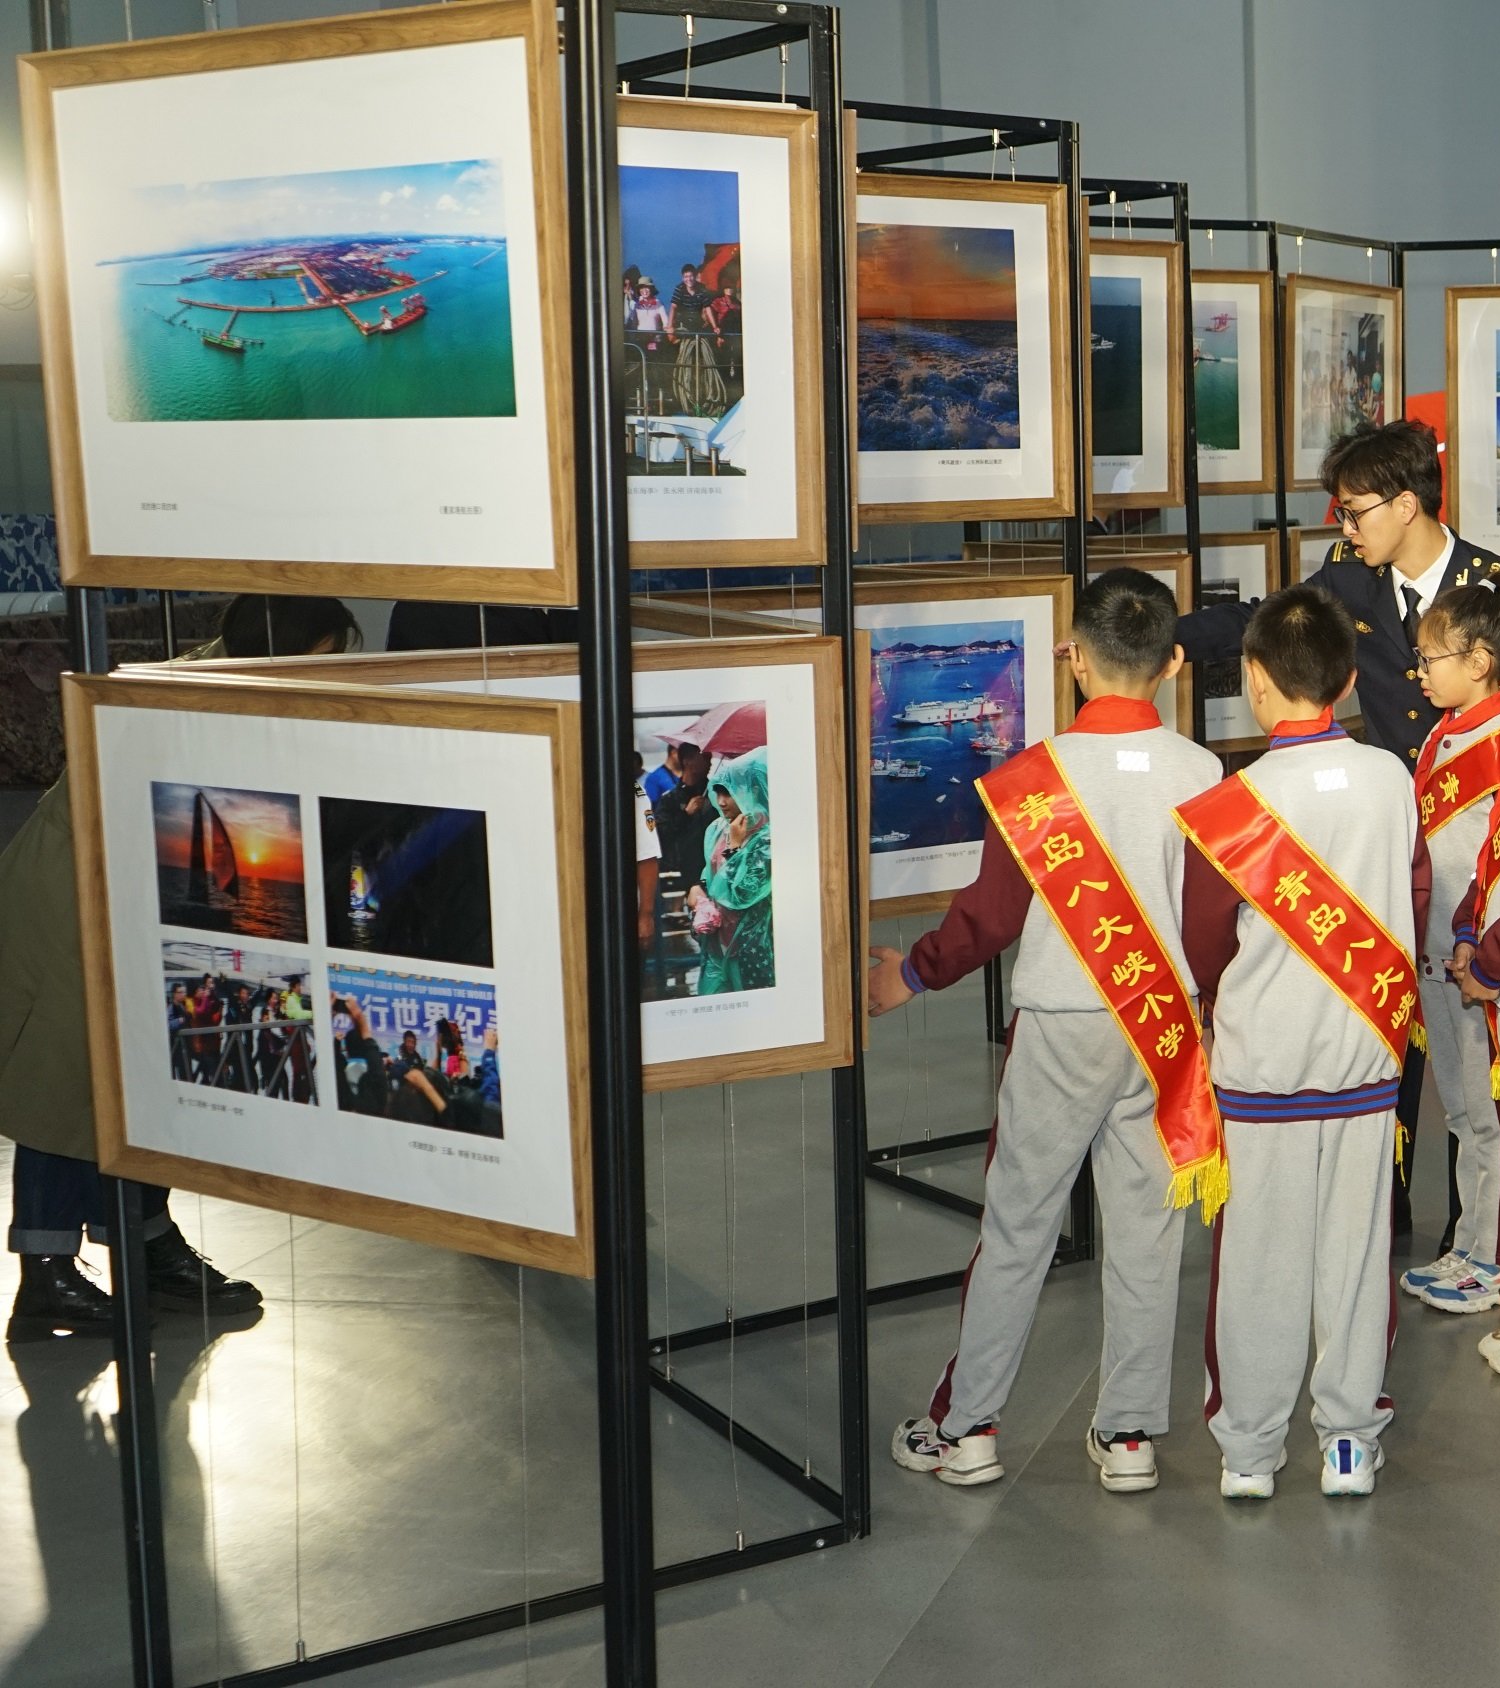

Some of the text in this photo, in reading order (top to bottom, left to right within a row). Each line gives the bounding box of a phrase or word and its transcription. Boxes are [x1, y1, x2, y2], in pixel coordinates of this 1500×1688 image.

[1015, 791, 1185, 1059] 青岛八大峡小学
[1274, 870, 1417, 1030] 青岛八大峡
